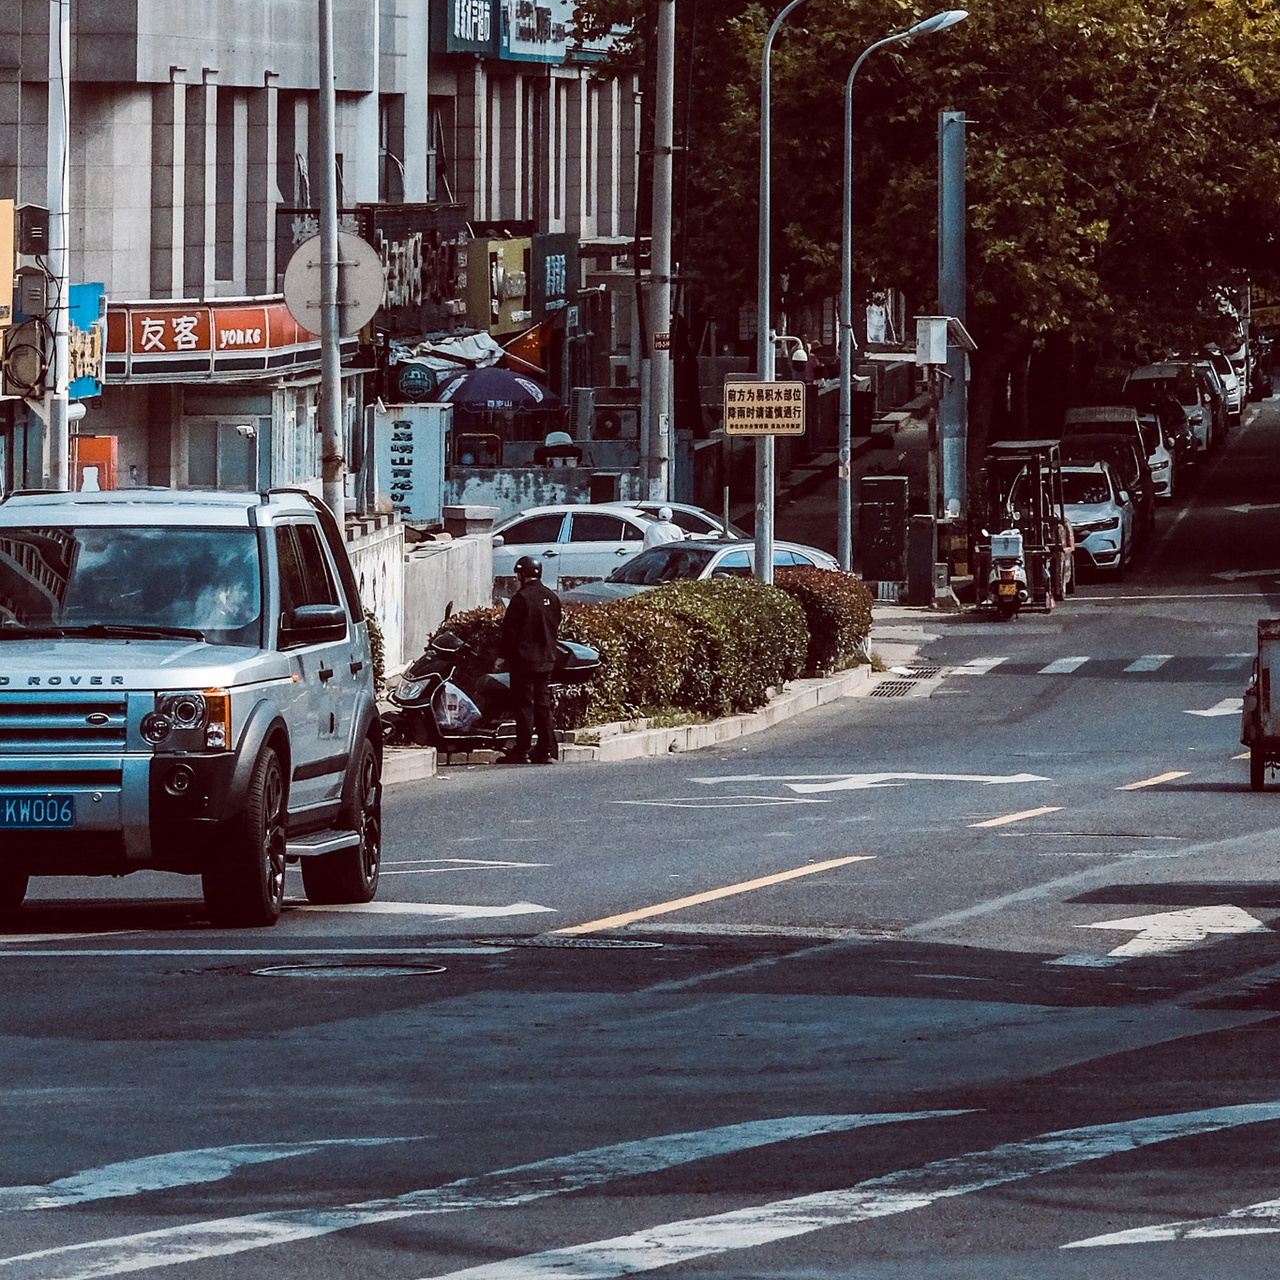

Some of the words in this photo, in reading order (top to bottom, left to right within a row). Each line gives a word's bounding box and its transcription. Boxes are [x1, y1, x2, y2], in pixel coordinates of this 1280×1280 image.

[140, 314, 199, 351] 友客
[727, 388, 802, 402] 前方为易积水部位
[727, 406, 802, 420] 降雨时请谨慎通行
[27, 675, 124, 686] ROVER
